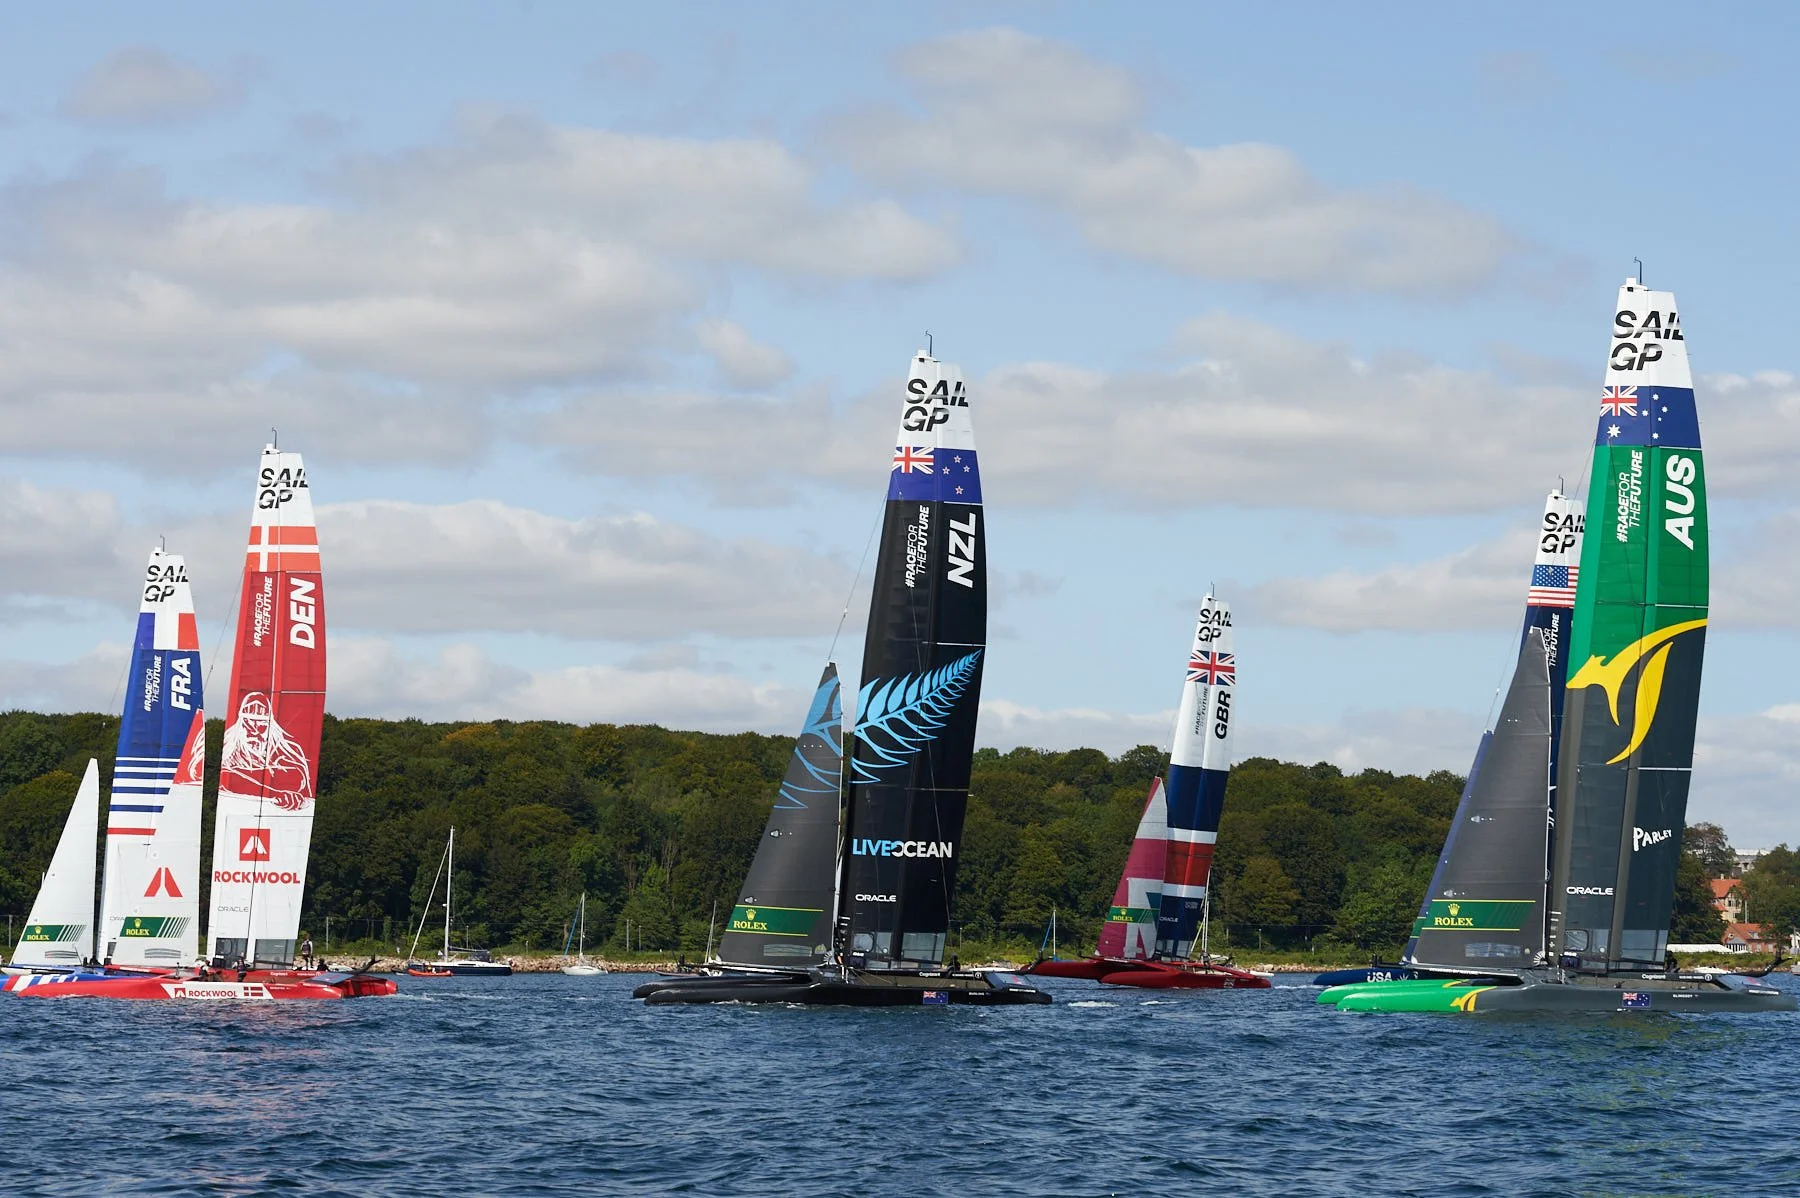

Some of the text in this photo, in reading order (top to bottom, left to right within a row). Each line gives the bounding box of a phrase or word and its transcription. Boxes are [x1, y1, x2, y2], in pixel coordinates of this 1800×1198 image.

[1610, 342, 1664, 371] GP
[902, 406, 950, 432] GP
[259, 467, 309, 488] SAIL
[1629, 449, 1643, 528] THEFUTURE
[257, 489, 294, 510] GP
[1616, 472, 1631, 543] #RACEFOR
[1664, 454, 1696, 551] AUS
[916, 505, 930, 575] THEFUTURE
[947, 512, 976, 589] NZL
[1541, 533, 1576, 553] GP
[905, 524, 919, 588] #RACEFOR
[146, 564, 189, 583] SAIL
[144, 585, 176, 602] GP
[262, 575, 273, 635] THEFUTURE
[253, 593, 264, 647] #RACEFOR
[290, 576, 316, 649] DEN
[1198, 626, 1222, 642] GP
[1549, 613, 1560, 666] THEFUTURE
[152, 655, 162, 702] THEFUTURE
[171, 658, 192, 711] FRA
[1214, 690, 1231, 740] GBR
[213, 870, 301, 885] ROCKWOOL
[855, 893, 897, 903] ORACLE
[1566, 886, 1614, 896] ORACLE
[217, 905, 249, 913] ORACLE
[126, 928, 150, 936] ROLEX
[733, 920, 768, 930] ROLEX
[1434, 917, 1474, 927] ROLEX
[1367, 971, 1393, 983] USA
[188, 990, 238, 998] ROCKWOOL
